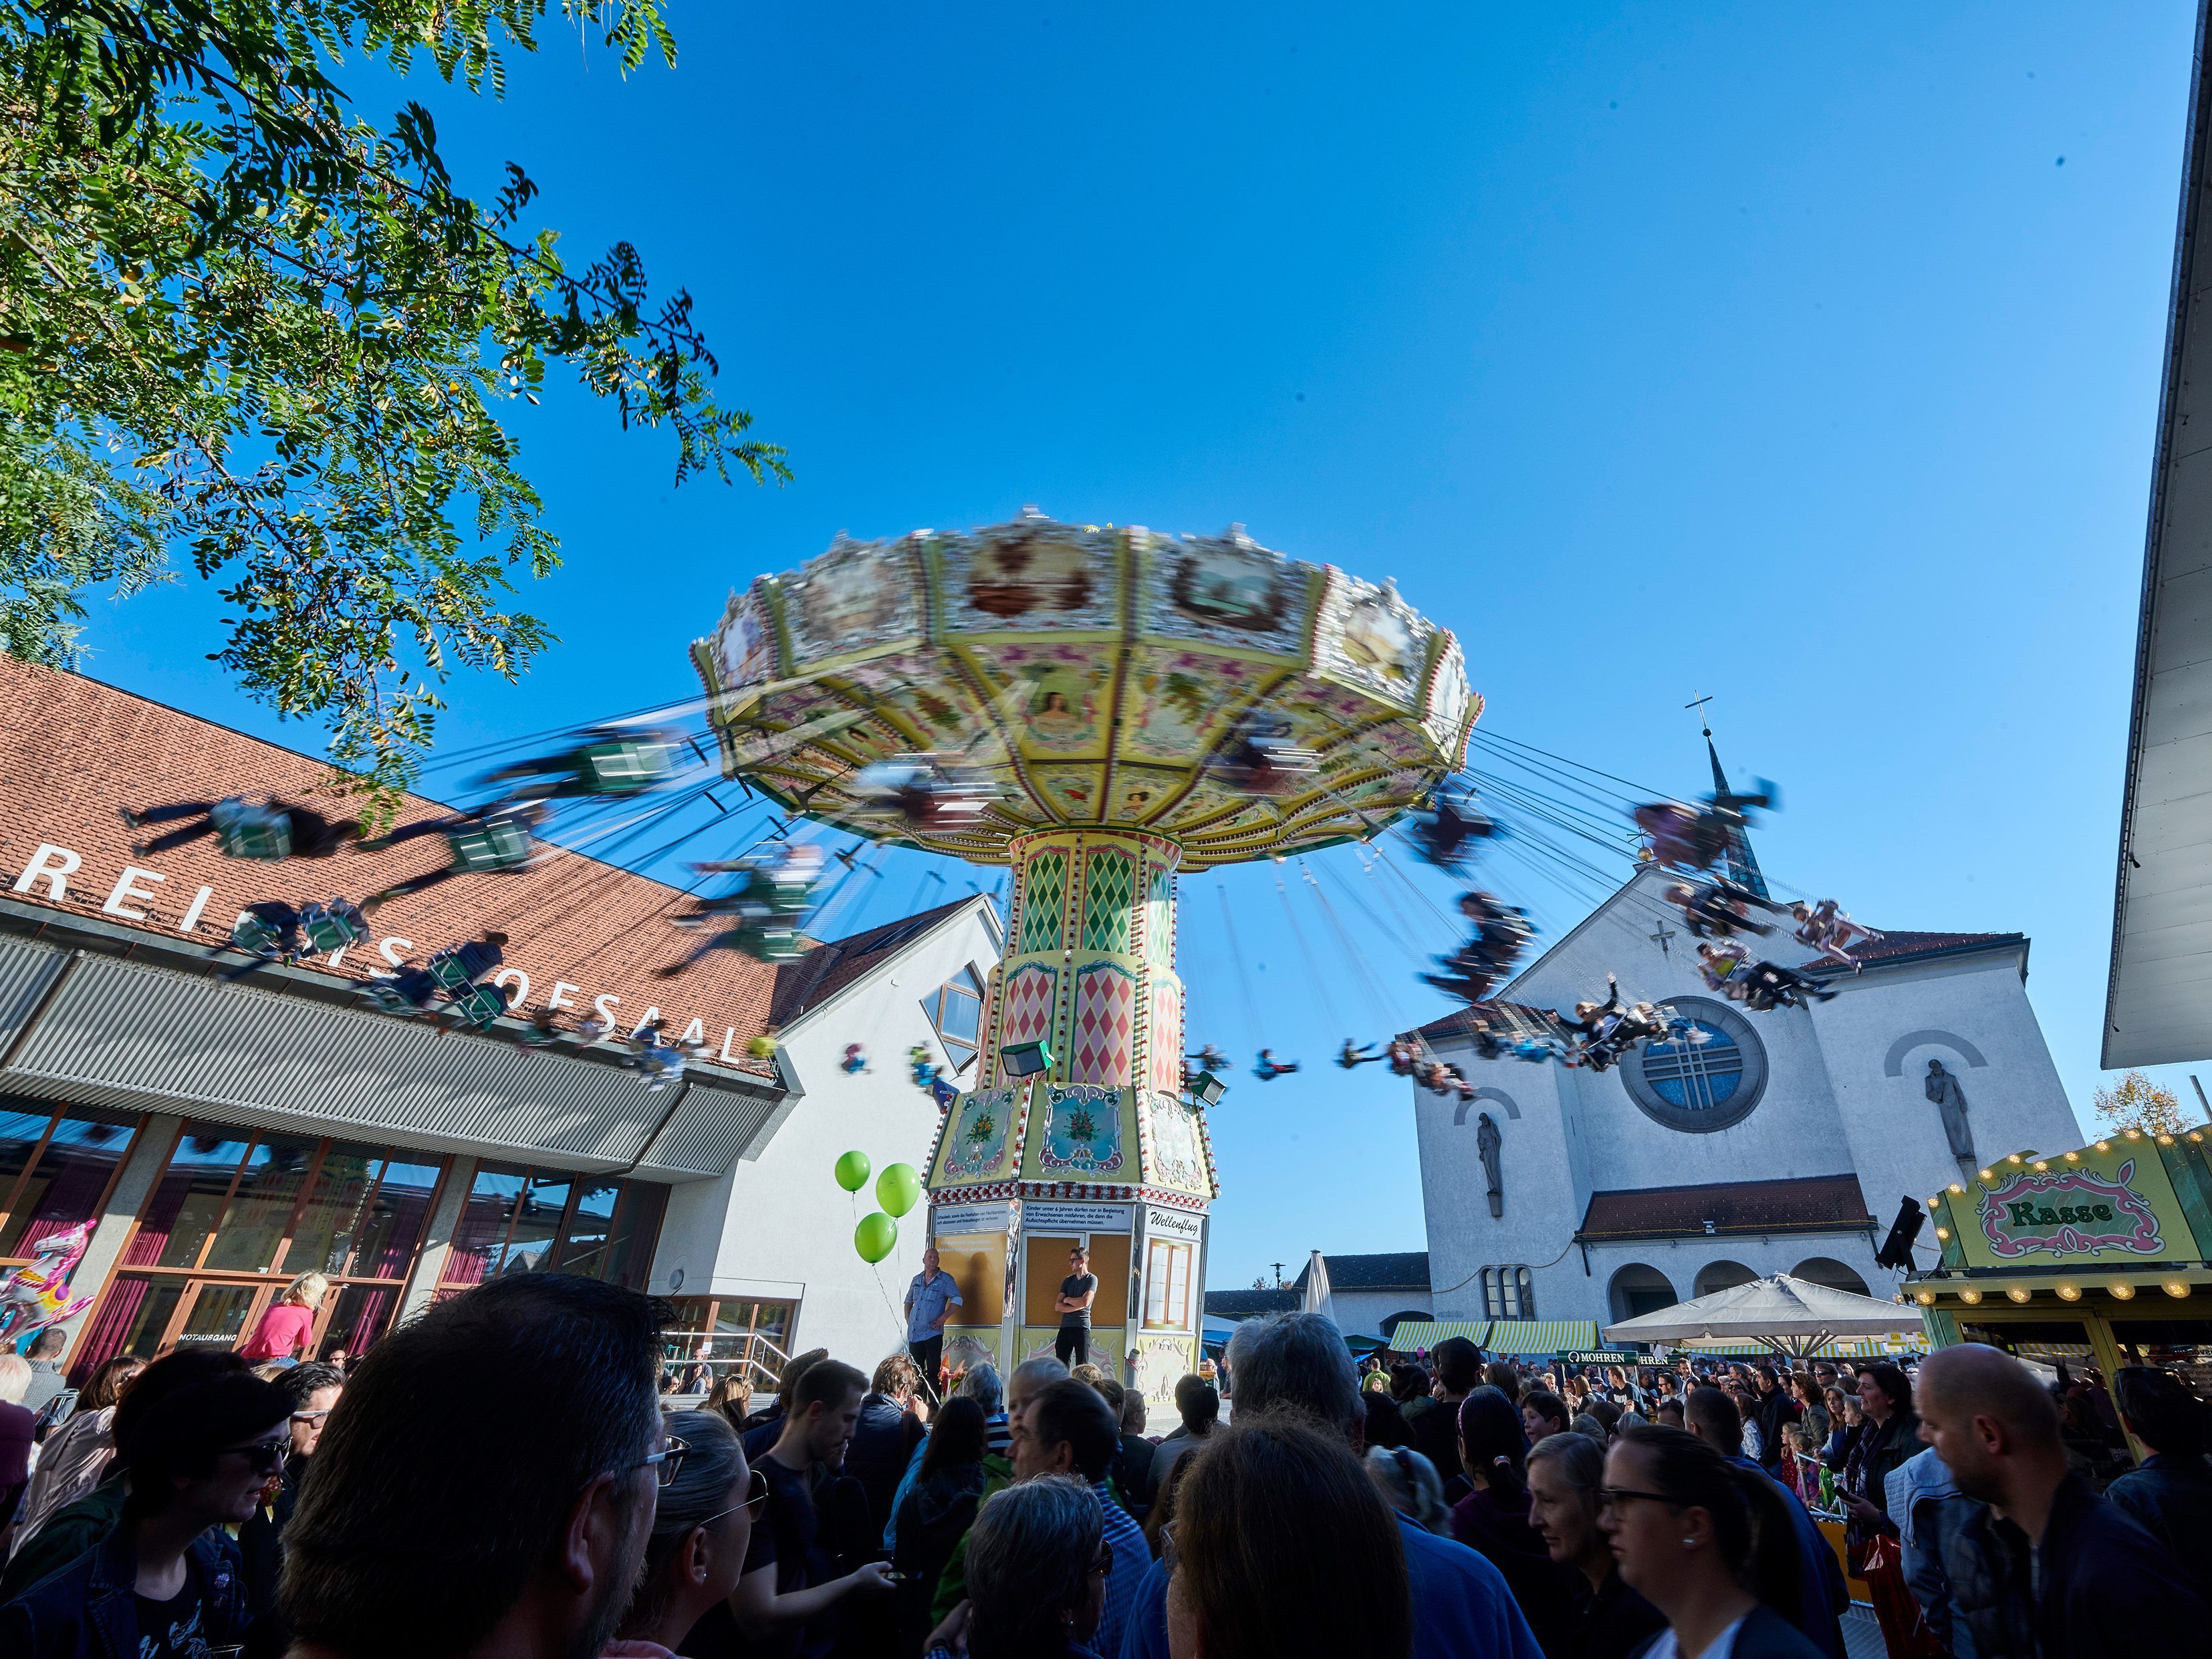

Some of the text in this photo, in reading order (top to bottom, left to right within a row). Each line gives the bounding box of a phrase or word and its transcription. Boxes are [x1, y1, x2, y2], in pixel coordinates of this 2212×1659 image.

[2007, 1202, 2113, 1227] Kasse
[1150, 1211, 1198, 1237] Wellenflug
[178, 1333, 237, 1342] NOTAUSGANG
[1580, 1353, 1625, 1363] MOHREN
[1639, 1356, 1669, 1365] HREN
